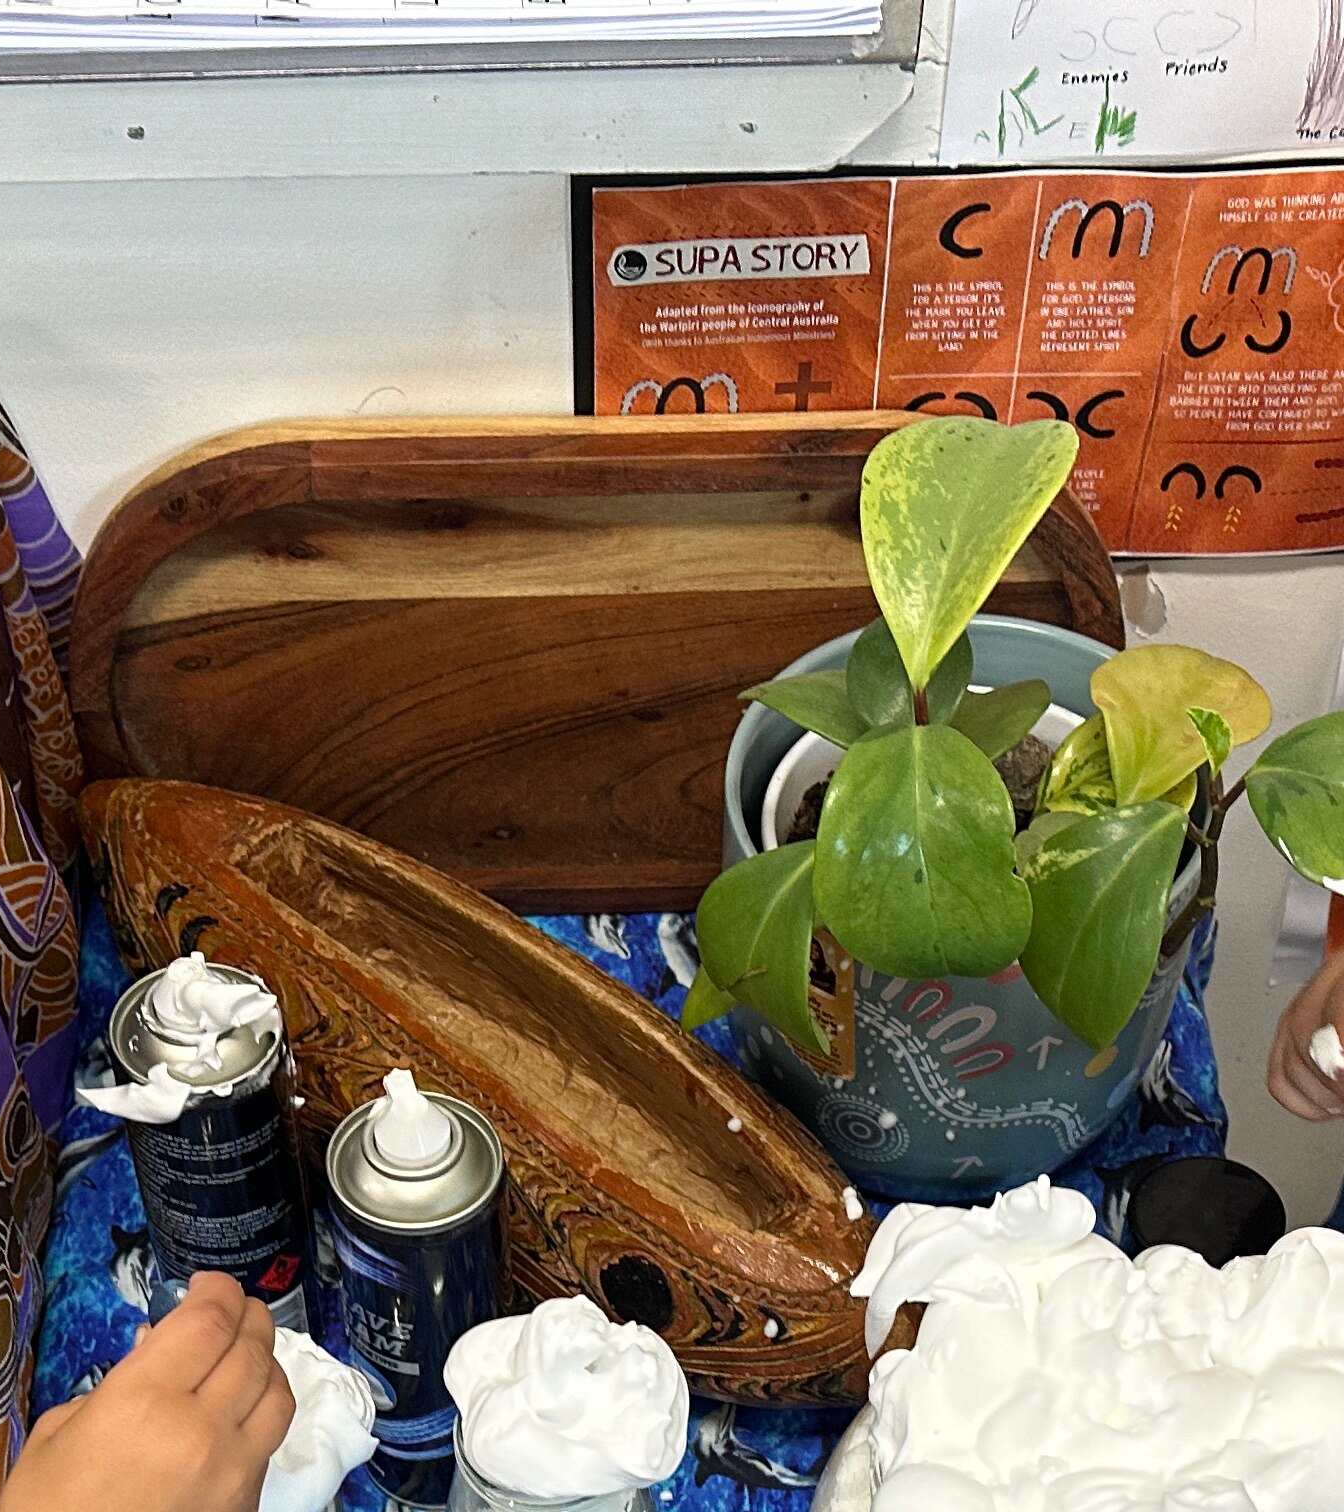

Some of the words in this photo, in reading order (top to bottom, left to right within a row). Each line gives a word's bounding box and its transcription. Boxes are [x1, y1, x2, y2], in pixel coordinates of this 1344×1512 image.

[1061, 67, 1129, 85] Enemies
[1165, 56, 1228, 76] Friends
[655, 247, 742, 277] SUPA
[751, 242, 860, 273] STORY
[655, 304, 698, 318] Adapted
[700, 302, 725, 316] from
[728, 302, 745, 315] the
[813, 299, 824, 312] of
[640, 321, 656, 334] the
[702, 318, 736, 333] people
[739, 316, 749, 328] of
[752, 315, 789, 329] Central
[792, 313, 839, 327] Australia
